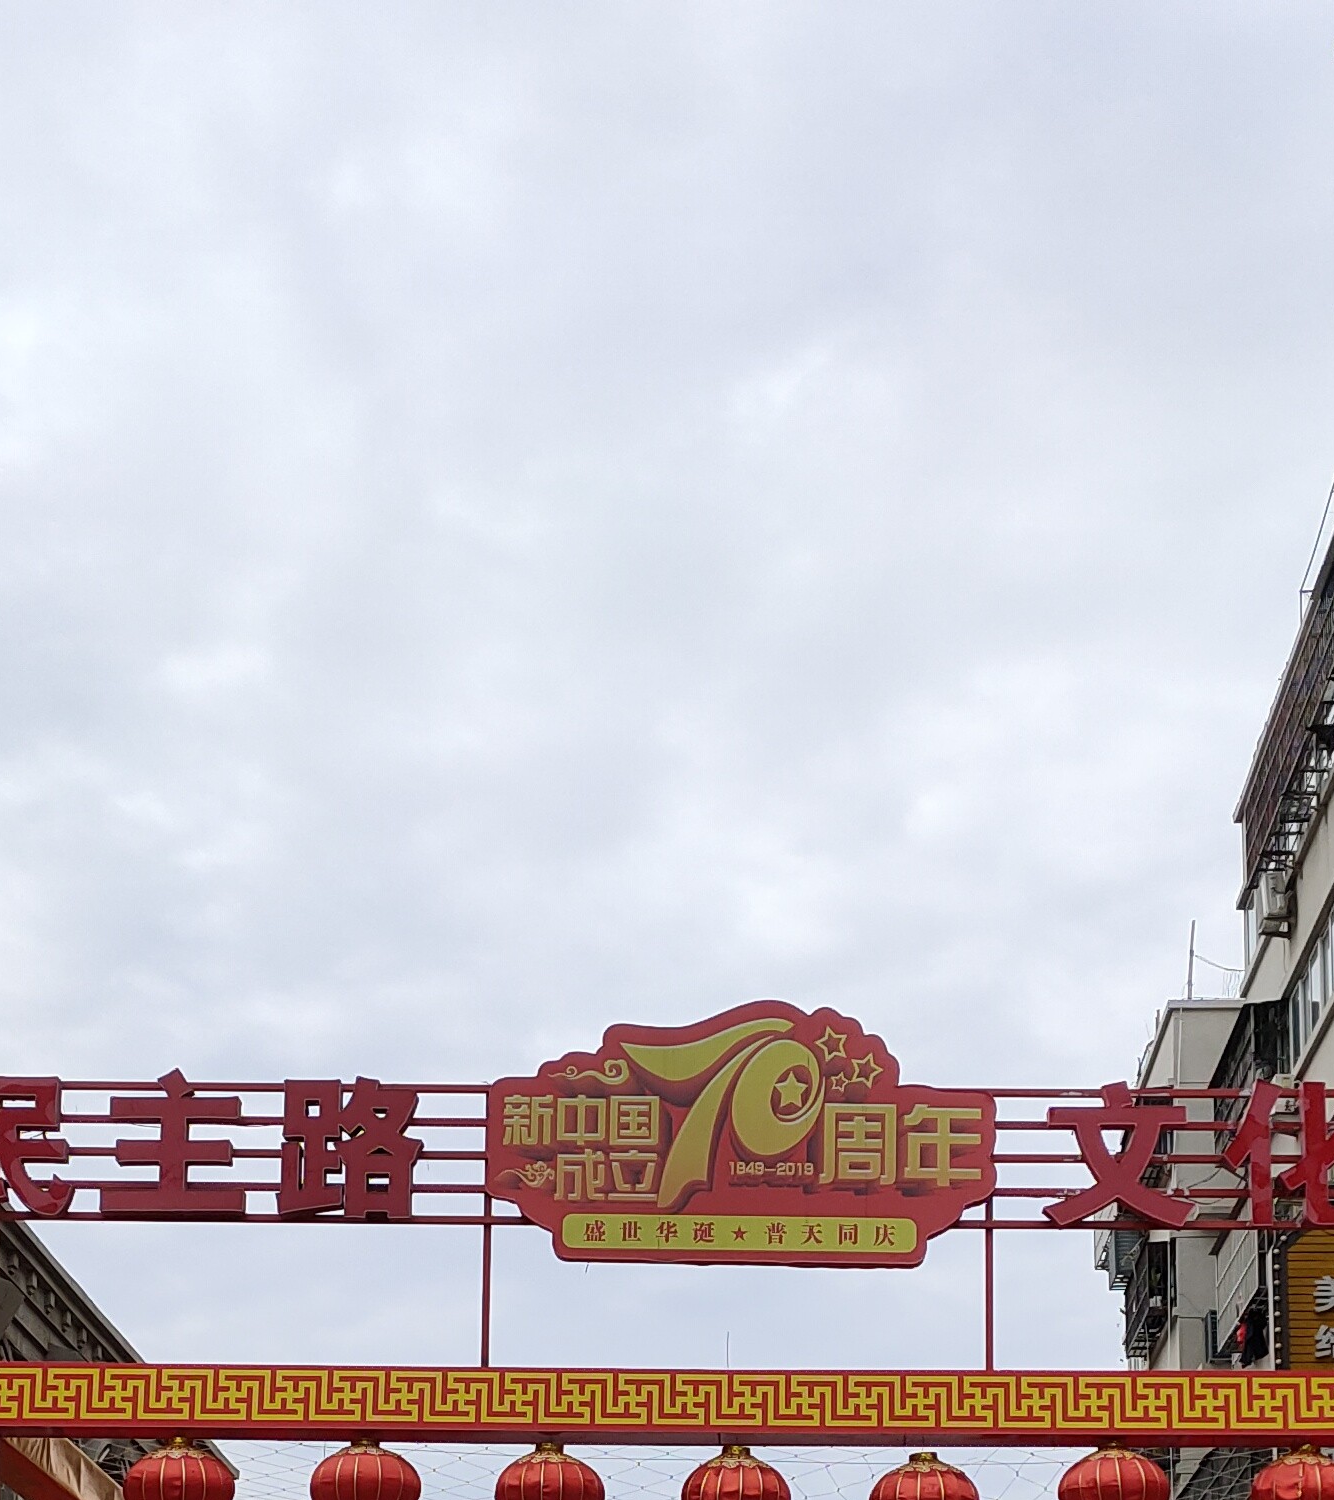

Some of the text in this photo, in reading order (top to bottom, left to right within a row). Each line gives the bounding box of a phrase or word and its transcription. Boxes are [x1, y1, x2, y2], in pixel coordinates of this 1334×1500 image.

[503, 1095, 661, 1146] 新中国
[818, 1101, 983, 1187] 周年
[554, 1150, 659, 1202] 成立
[583, 1220, 897, 1246] 盛世华诞 普天同庆
